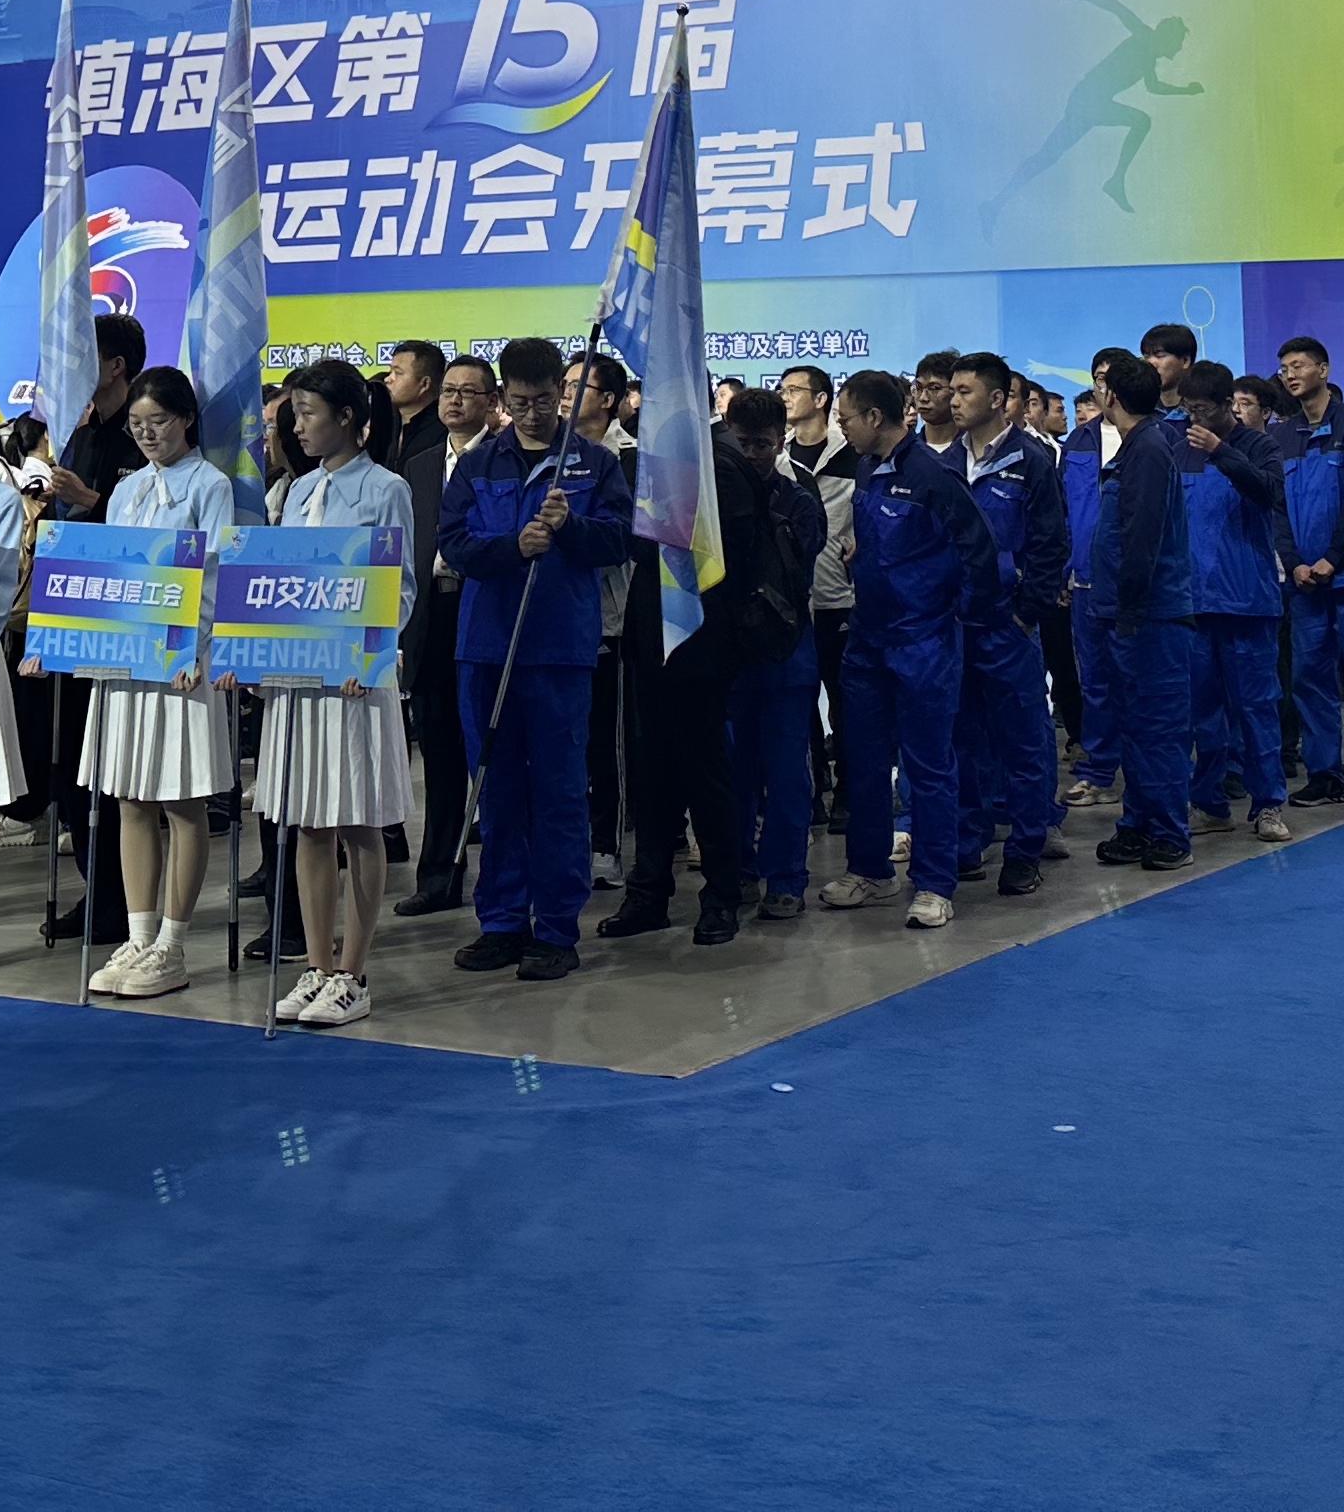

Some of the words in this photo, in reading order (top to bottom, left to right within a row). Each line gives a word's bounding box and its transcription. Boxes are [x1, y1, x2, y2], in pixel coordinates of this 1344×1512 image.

[260, 121, 926, 264] 运动会开幕式
[45, 573, 184, 608] 区直属基层工会
[246, 575, 367, 611] 中交水利
[26, 626, 146, 665] ZHENHAI
[211, 637, 342, 670] ZHENHAI
